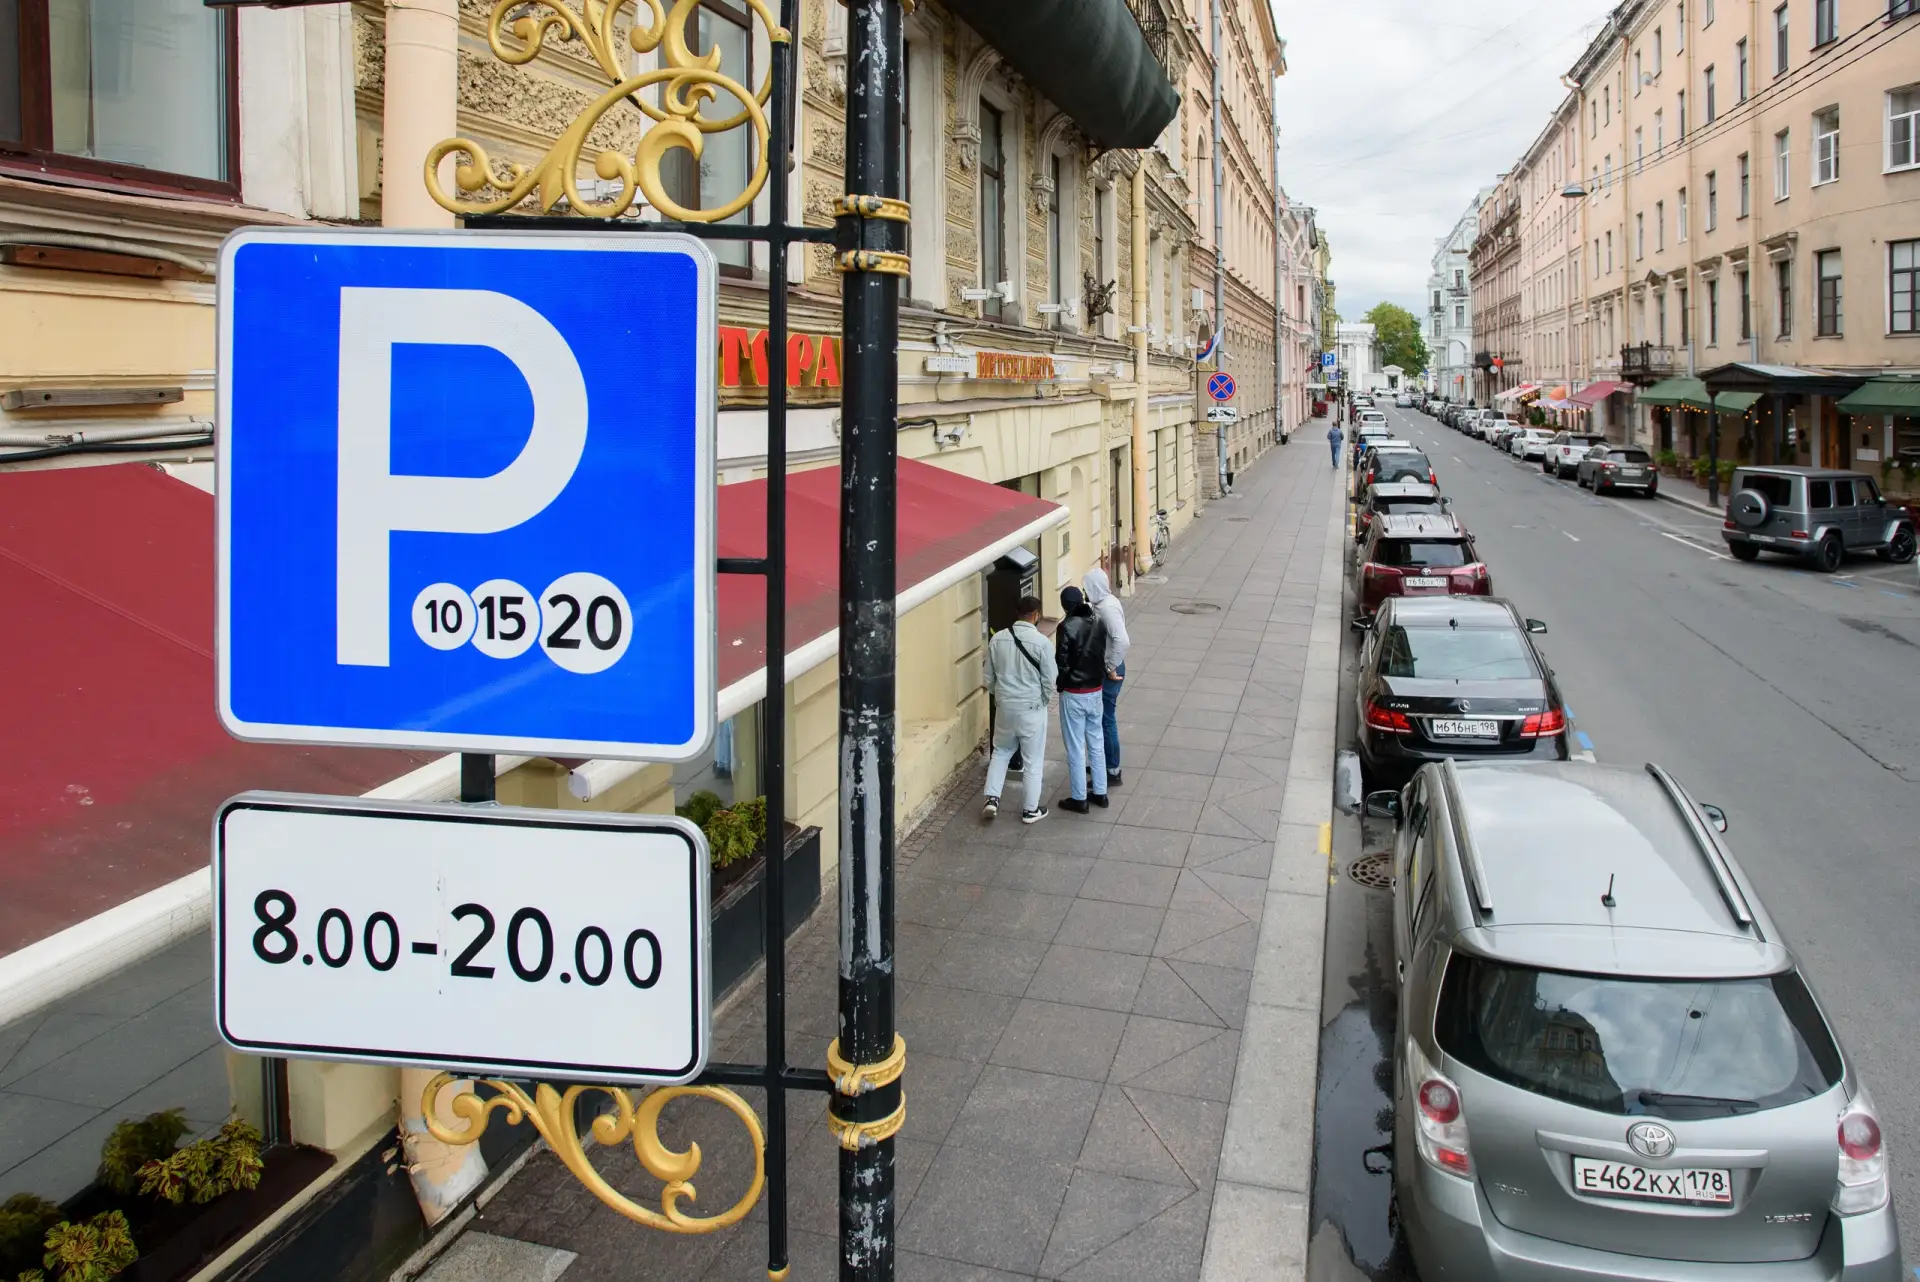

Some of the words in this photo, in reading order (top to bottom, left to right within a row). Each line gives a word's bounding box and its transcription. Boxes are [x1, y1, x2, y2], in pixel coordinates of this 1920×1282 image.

[337, 286, 589, 667] P
[425, 599, 463, 634] 10
[478, 596, 527, 641] 15
[546, 593, 622, 651] 20
[1479, 721, 1495, 731] 198
[1687, 1171, 1723, 1191] 178
[1695, 1190, 1715, 1199] RUS
